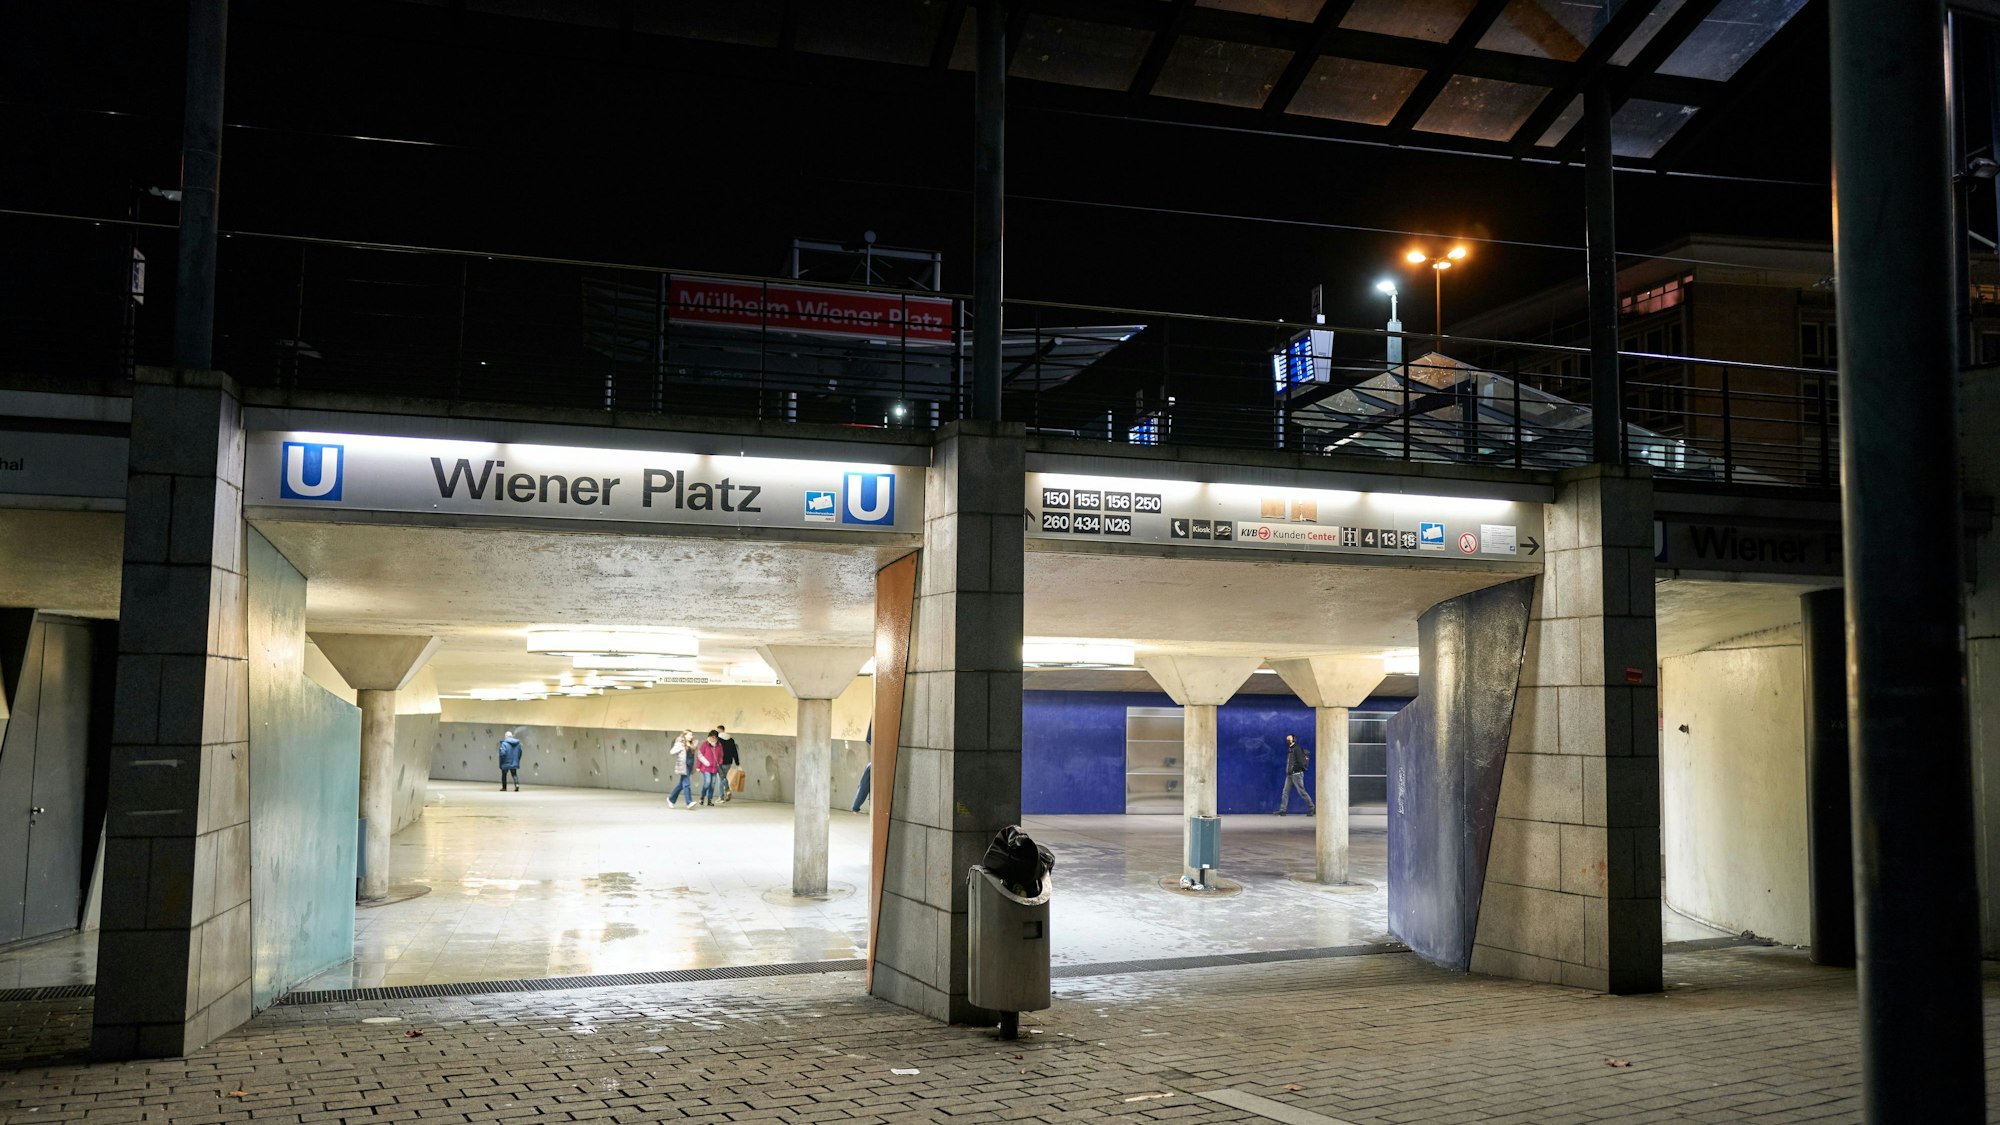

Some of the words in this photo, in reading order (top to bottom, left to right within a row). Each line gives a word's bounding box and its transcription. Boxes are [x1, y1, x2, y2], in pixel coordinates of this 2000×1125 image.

[679, 289, 789, 320] Mülheim
[796, 299, 883, 328] Wiener
[888, 307, 944, 333] Platz
[286, 445, 339, 497] U
[430, 457, 620, 507] Wiener
[642, 468, 762, 513] Platz
[847, 475, 891, 522] U
[1043, 491, 1069, 506] 150
[1074, 493, 1100, 508] 155
[1105, 495, 1130, 509] 156
[1135, 496, 1161, 511] 250
[1043, 515, 1069, 530] 260
[1074, 516, 1100, 531] 434
[1105, 518, 1130, 533] N26
[1192, 525, 1211, 533] Kiosk
[1240, 528, 1258, 537] KVB
[1272, 530, 1306, 540] Kunden
[1307, 531, 1336, 541] Center
[1364, 531, 1374, 545] 4
[1381, 533, 1396, 546] 13
[1689, 525, 1806, 564] Wiener
